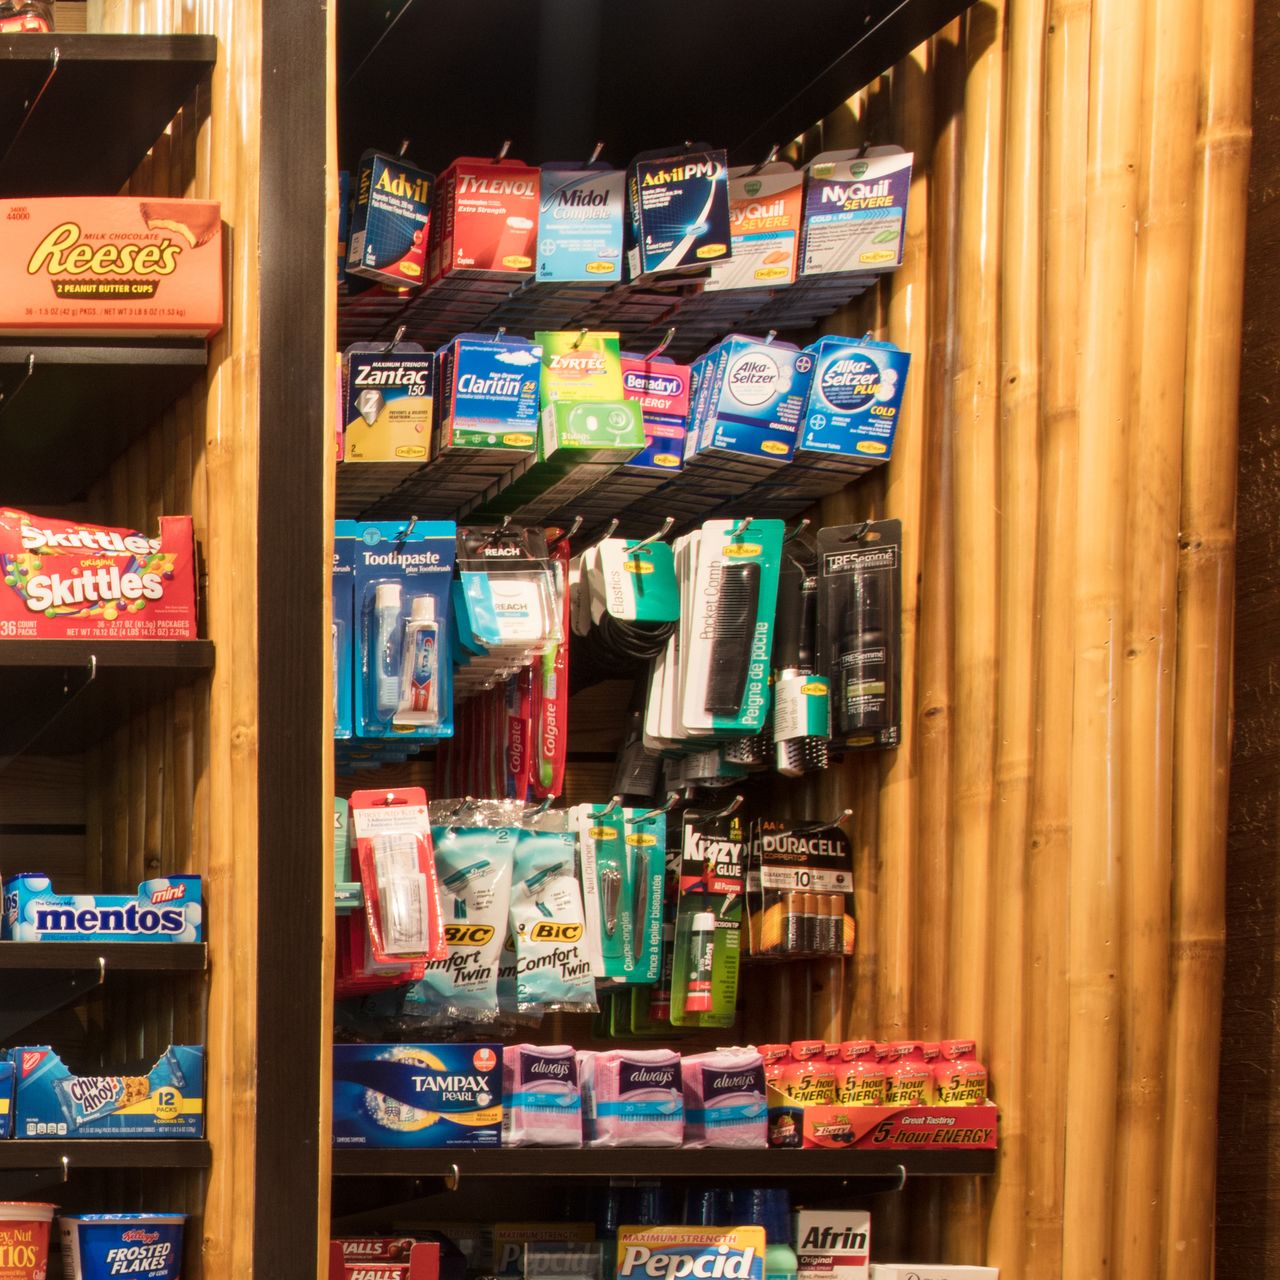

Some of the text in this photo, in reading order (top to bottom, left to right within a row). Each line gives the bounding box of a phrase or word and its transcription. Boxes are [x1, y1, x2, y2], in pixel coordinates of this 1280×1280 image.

[458, 174, 535, 197] TYLENOL
[557, 188, 610, 209] Midol
[108, 233, 159, 241] CHOCOLATE
[29, 223, 182, 274] Reese's
[57, 285, 153, 293] 2 PEANUT BUTTER CUPS
[357, 365, 428, 385] Zantac
[408, 384, 425, 396] 150
[458, 373, 520, 396] Claritin
[363, 550, 440, 567] Toothpaste
[485, 546, 520, 557] REACH
[28, 567, 164, 611] Skittles
[0, 621, 16, 635] 36
[762, 836, 846, 858] DURACELL
[36, 904, 184, 932] mentos
[412, 1075, 491, 1092] TAMPAX
[442, 1092, 474, 1103] PEARL
[10, 1230, 32, 1243] Nut
[622, 1233, 737, 1243] MAXIMUM STRENGTH
[801, 1225, 868, 1252] Afrin
